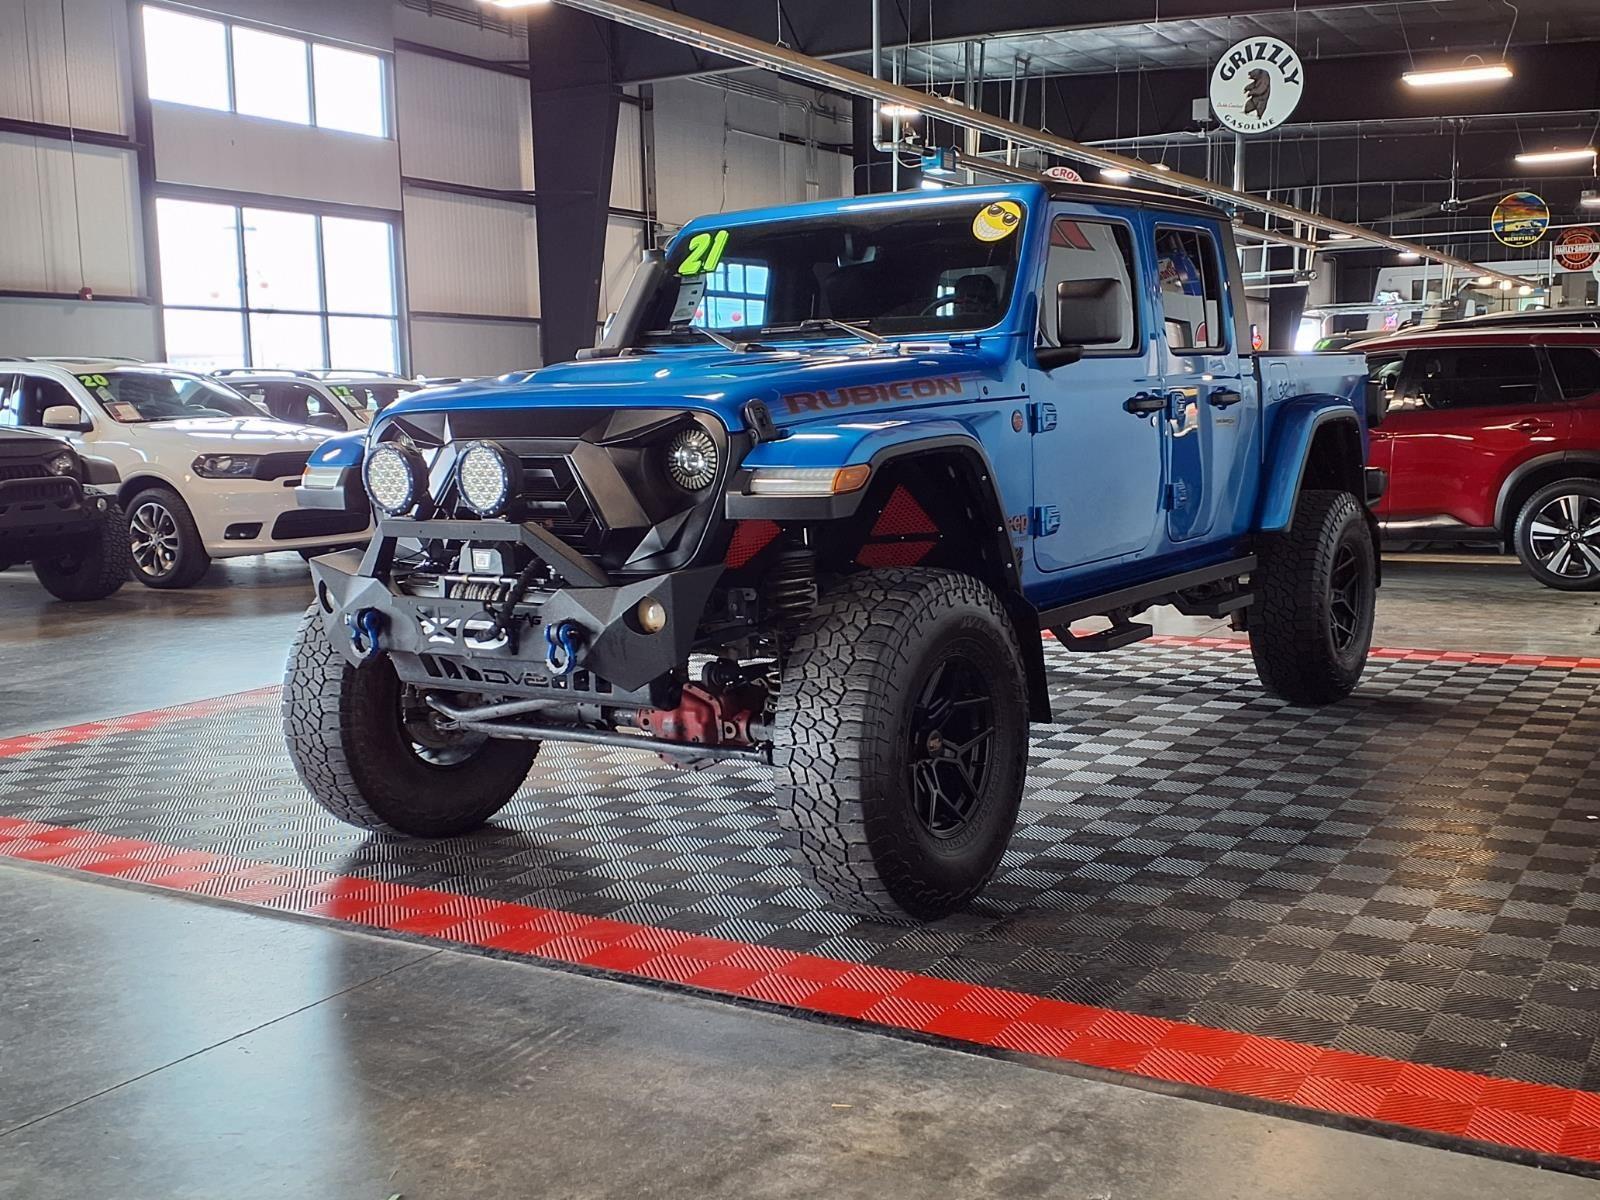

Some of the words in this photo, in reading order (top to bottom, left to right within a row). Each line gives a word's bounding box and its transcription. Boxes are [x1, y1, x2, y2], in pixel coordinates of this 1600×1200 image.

[1220, 42, 1299, 85] GRIZZLY
[1224, 114, 1275, 130] GASOLINE
[678, 230, 729, 275] 21
[78, 374, 109, 387] 20
[783, 376, 962, 414] RUBICON
